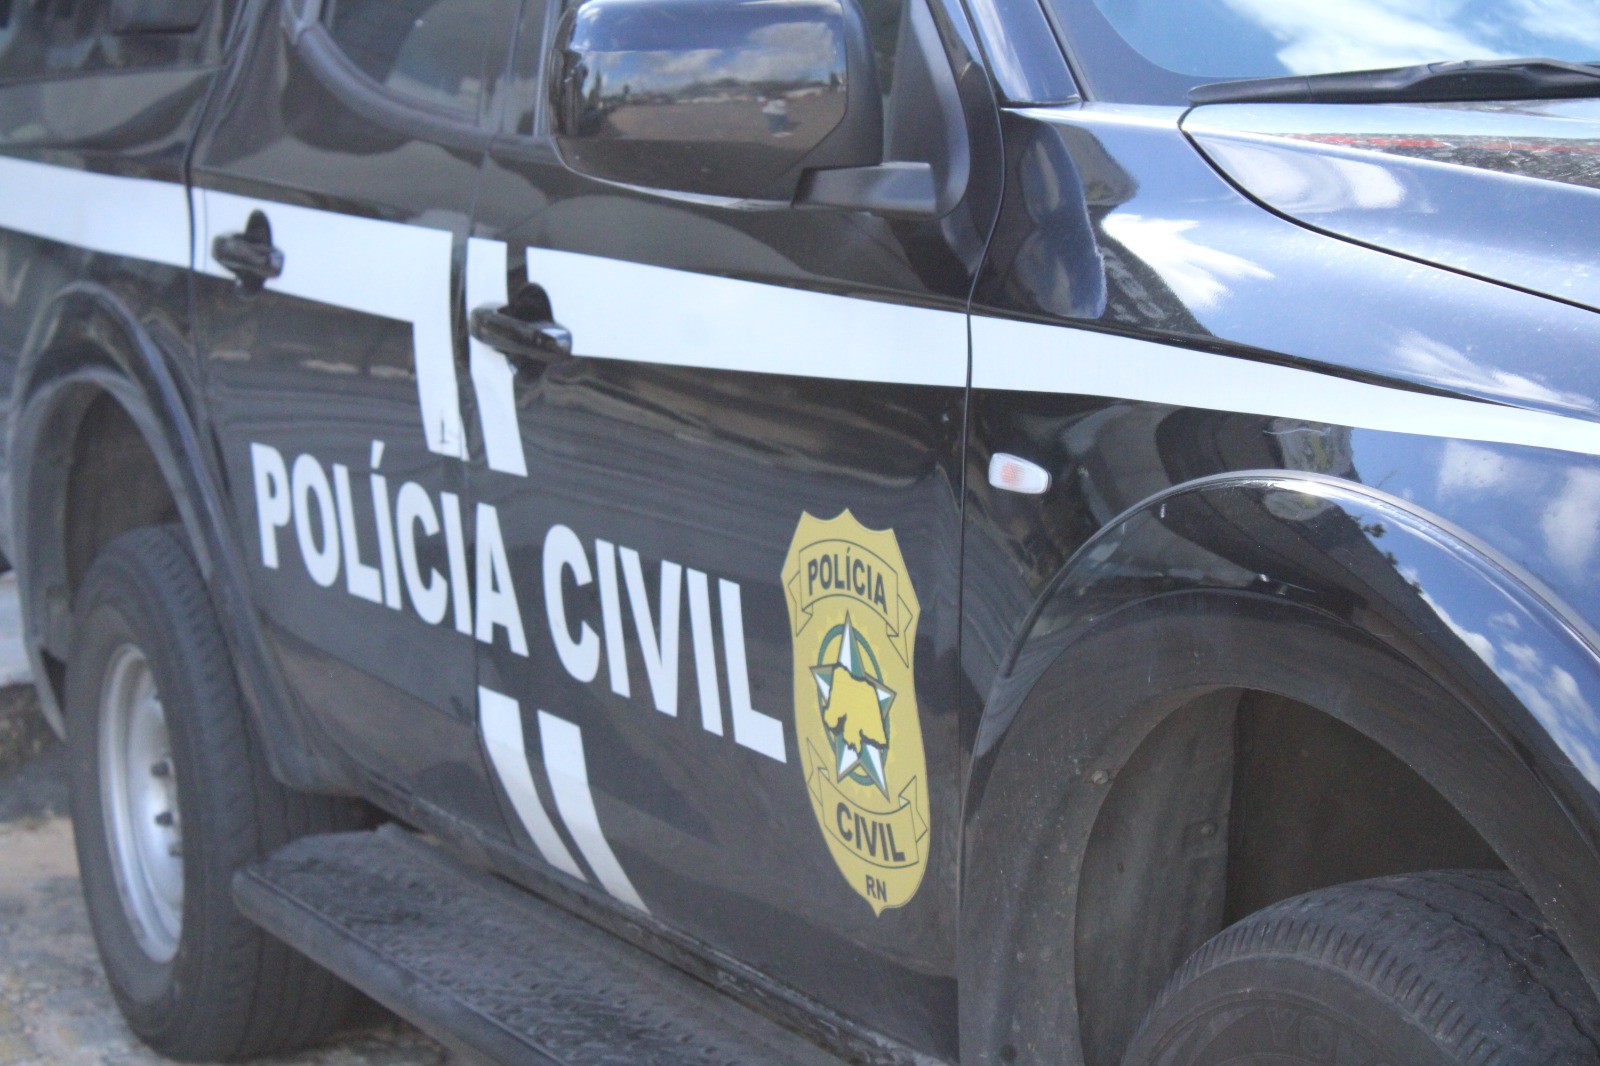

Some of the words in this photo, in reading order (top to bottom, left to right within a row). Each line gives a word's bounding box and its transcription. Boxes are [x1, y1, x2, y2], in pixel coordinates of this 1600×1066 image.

[250, 440, 529, 657] POLÍCIA
[542, 524, 787, 764] CIVIL
[808, 547, 888, 615] POLÍCIA
[837, 802, 906, 862] CIVIL
[865, 874, 888, 903] RN
